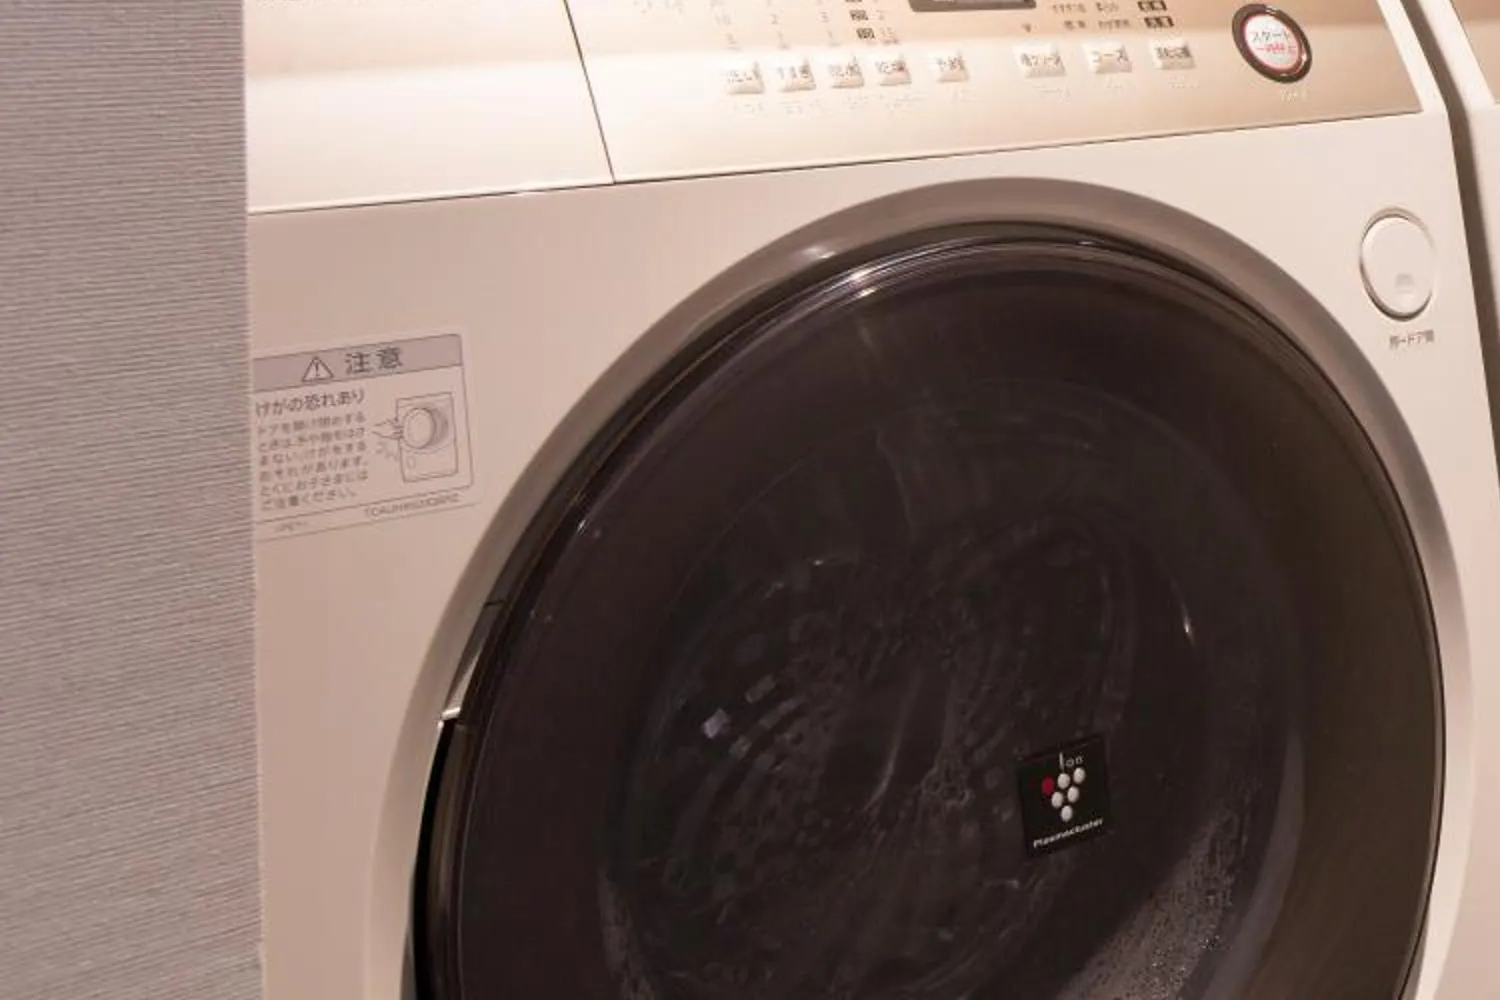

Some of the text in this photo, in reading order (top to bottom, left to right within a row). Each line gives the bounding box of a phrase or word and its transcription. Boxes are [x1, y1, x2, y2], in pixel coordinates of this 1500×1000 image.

[344, 346, 403, 374] 注意
[255, 387, 366, 418] けがの恐れあり
